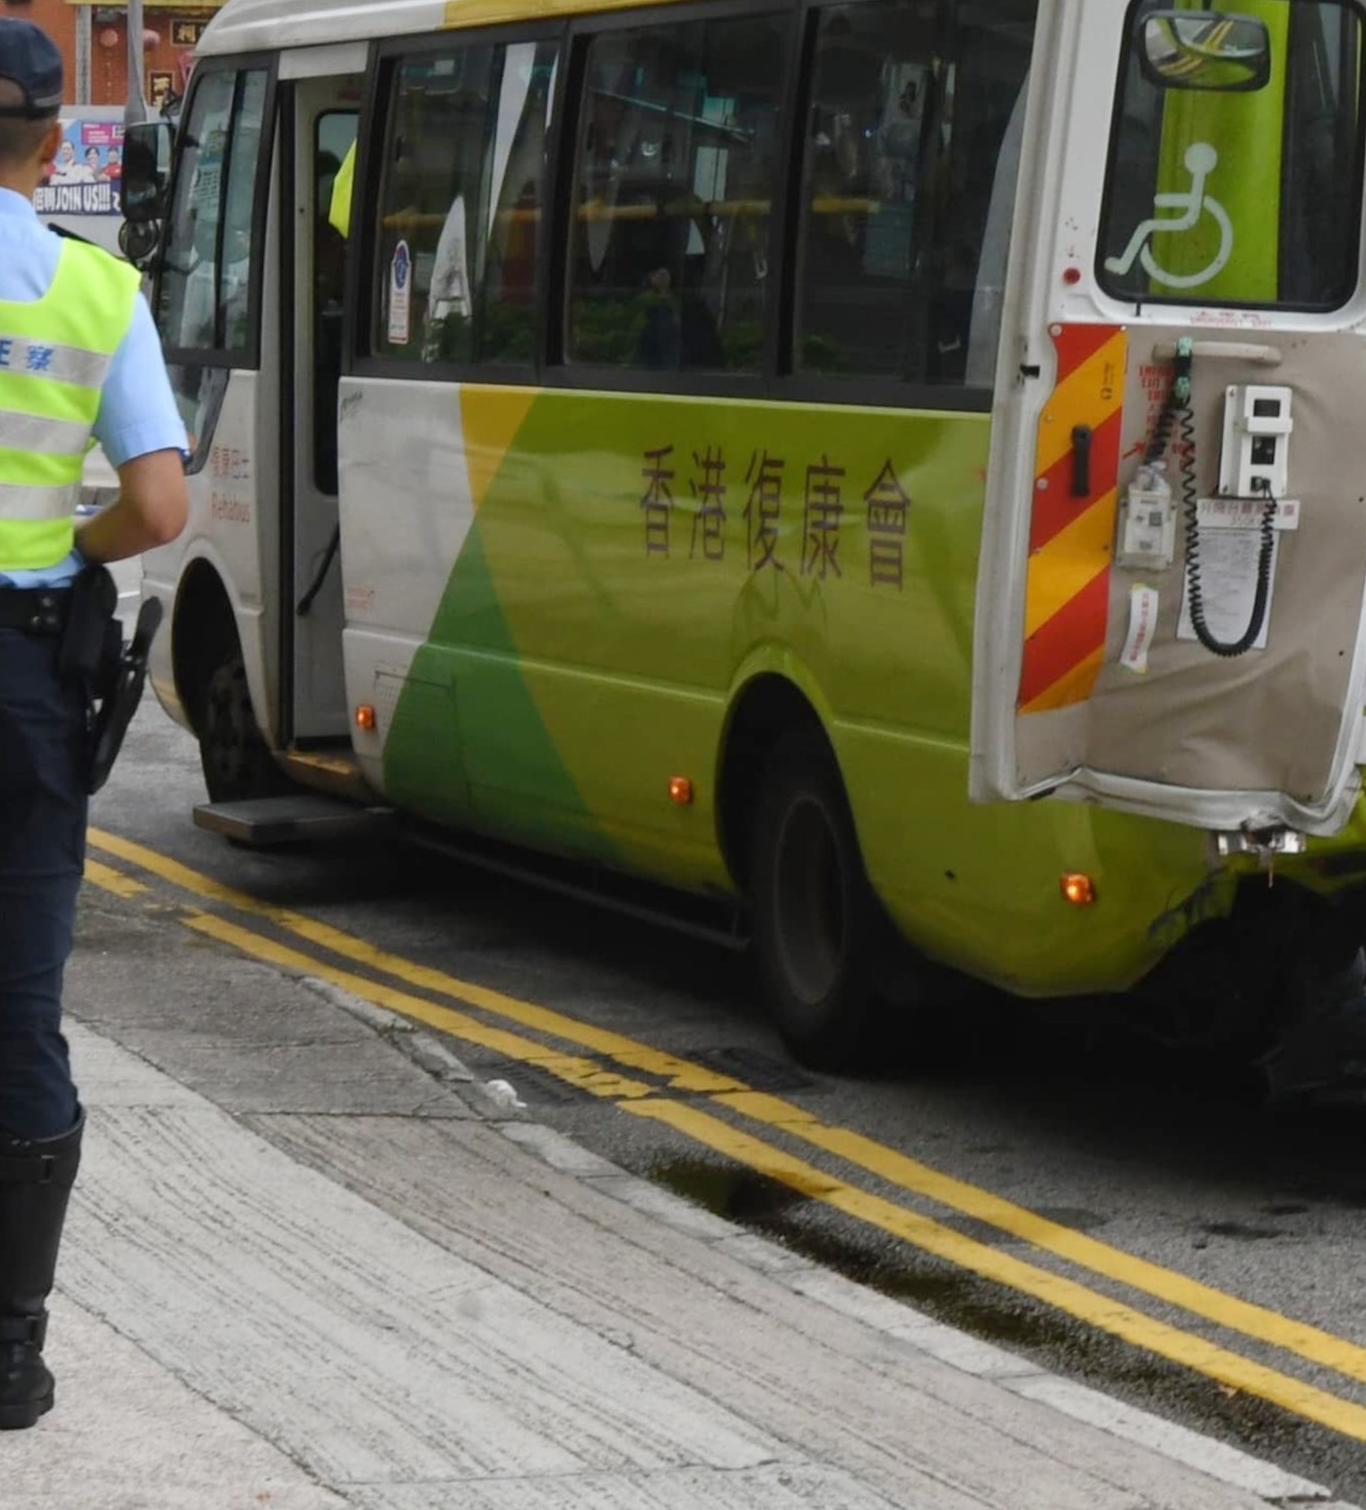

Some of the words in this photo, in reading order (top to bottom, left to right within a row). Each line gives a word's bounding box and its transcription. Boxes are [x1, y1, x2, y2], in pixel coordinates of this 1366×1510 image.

[640, 444, 911, 592] 香港復康會
